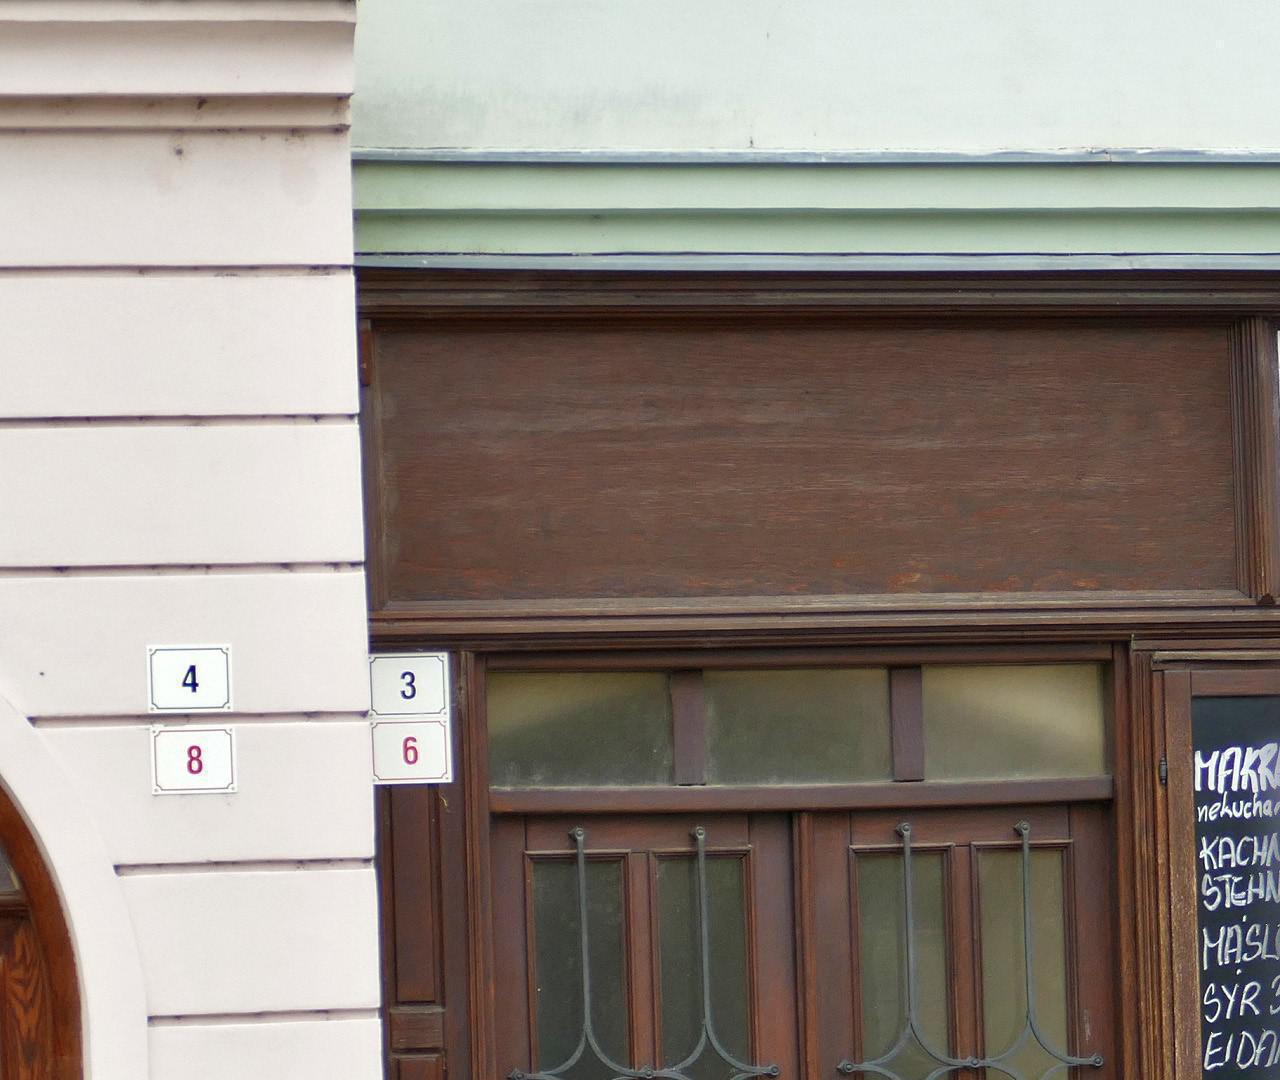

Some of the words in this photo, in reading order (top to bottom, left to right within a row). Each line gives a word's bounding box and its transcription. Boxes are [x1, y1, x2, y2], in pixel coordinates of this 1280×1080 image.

[182, 664, 199, 693] 4
[400, 671, 417, 700] 3
[186, 745, 204, 774] 8
[402, 736, 419, 765] 6
